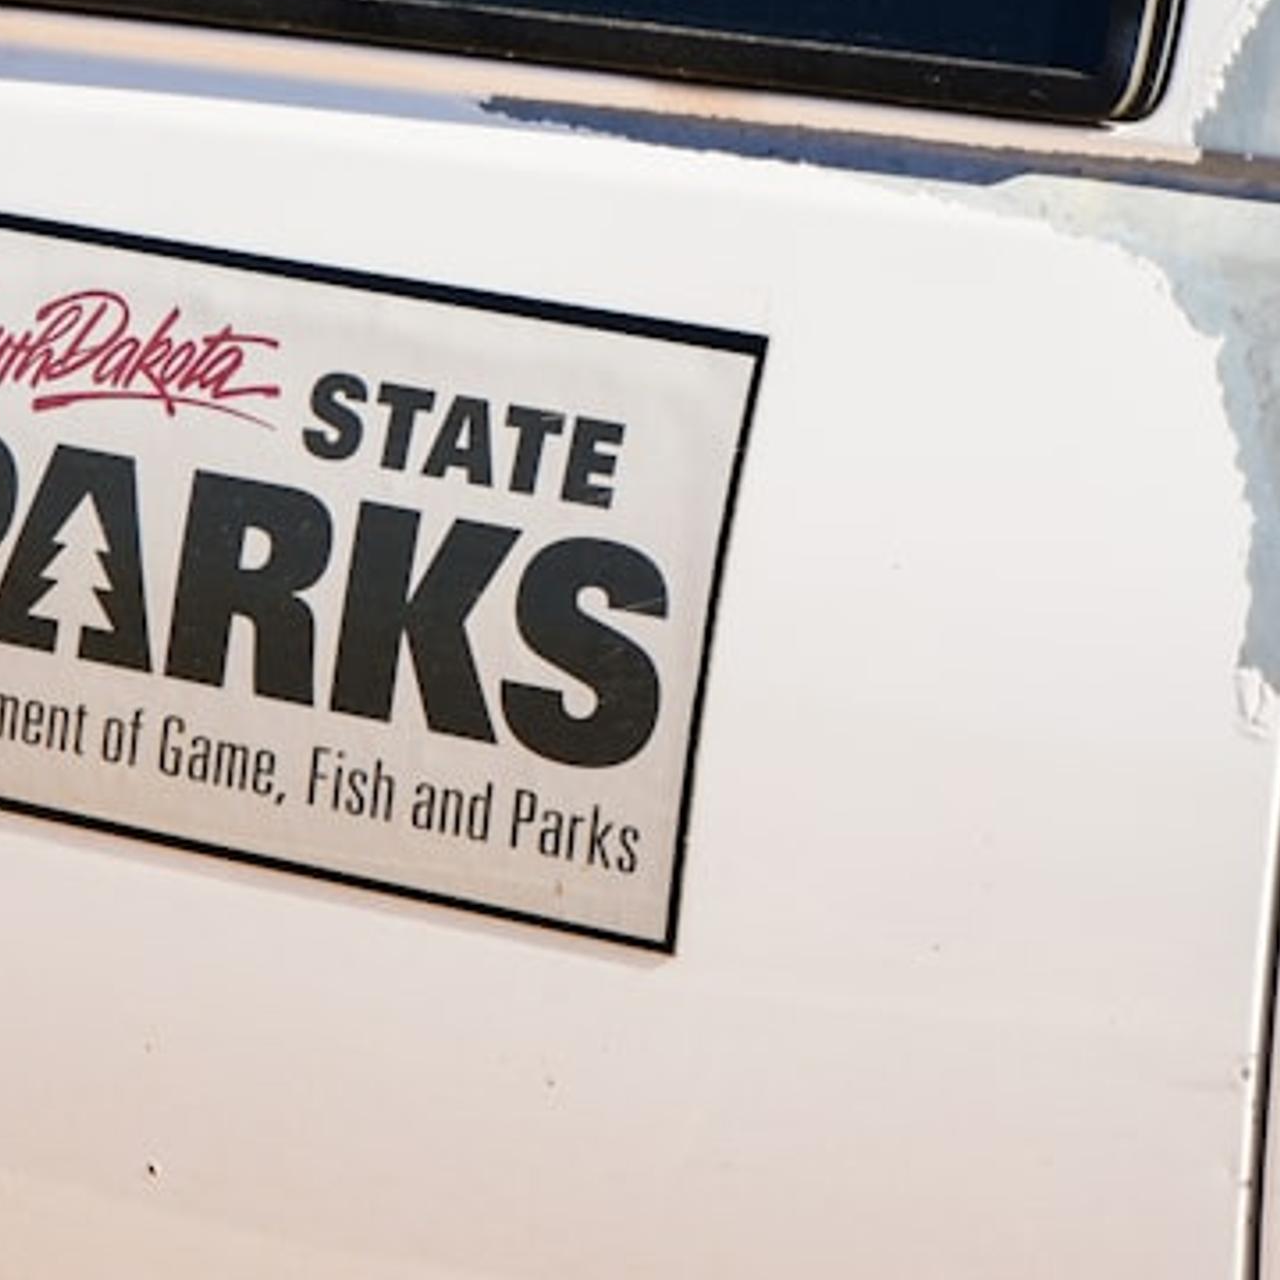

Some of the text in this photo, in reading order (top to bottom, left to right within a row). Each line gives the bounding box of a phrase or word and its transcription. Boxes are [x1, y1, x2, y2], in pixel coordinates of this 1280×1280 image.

[301, 372, 626, 510] STATE
[101, 708, 144, 767] of
[159, 715, 286, 806] Game,
[307, 745, 396, 822] Fish
[411, 781, 494, 842] and
[509, 788, 641, 874] Parks
